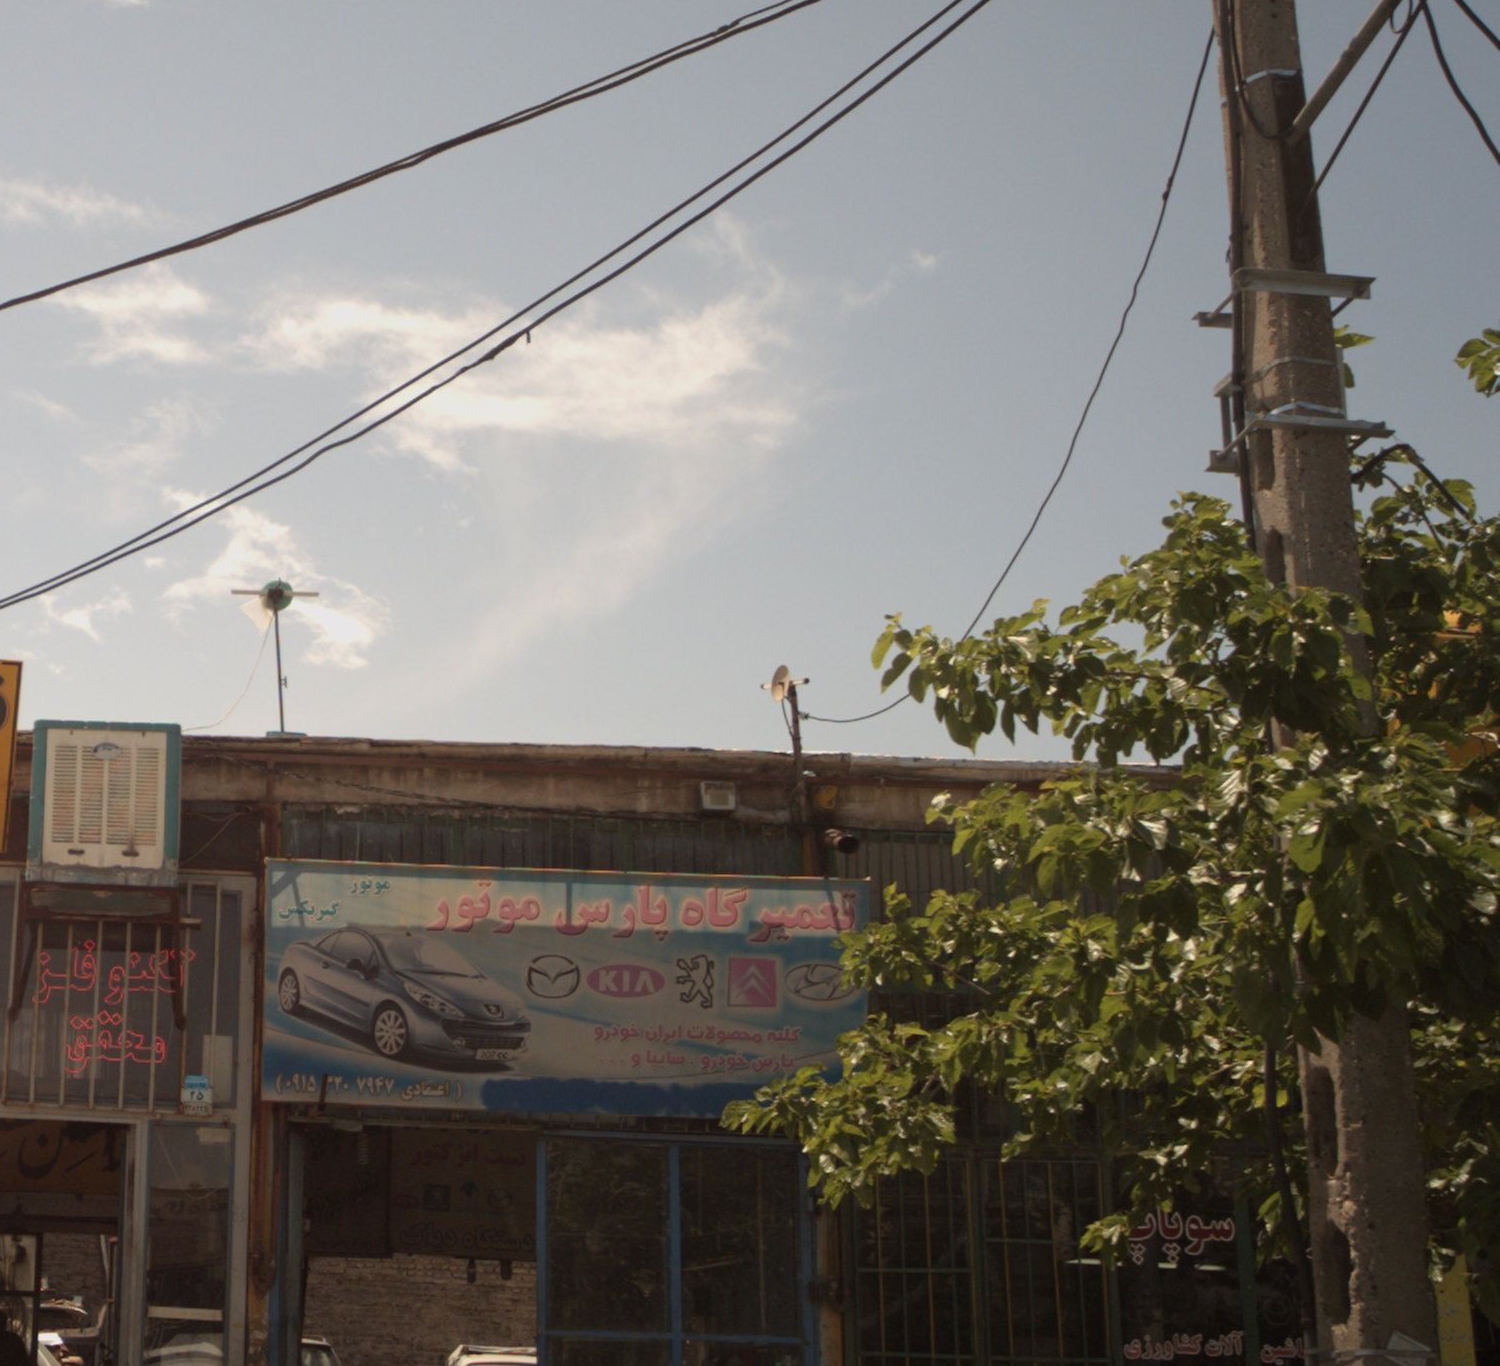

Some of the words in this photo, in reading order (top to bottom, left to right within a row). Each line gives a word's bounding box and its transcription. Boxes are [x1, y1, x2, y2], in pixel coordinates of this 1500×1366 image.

[351, 876, 390, 895] موتور
[426, 880, 542, 934] موتور
[553, 883, 668, 942] پارس
[597, 969, 656, 993] KIA
[63, 1009, 167, 1074] محقق
[594, 1023, 642, 1042] خودرو
[645, 1024, 683, 1042] ایران
[687, 1025, 763, 1044] محصولات
[766, 1024, 802, 1043] کلیه
[645, 1054, 686, 1068] سایپا
[700, 1052, 750, 1072] خودرو
[1128, 1207, 1237, 1266] سوپاپ
[1123, 1332, 1204, 1361] کشاورزی
[1204, 1329, 1244, 1358] آلات
[1260, 1336, 1306, 1366] اشین
